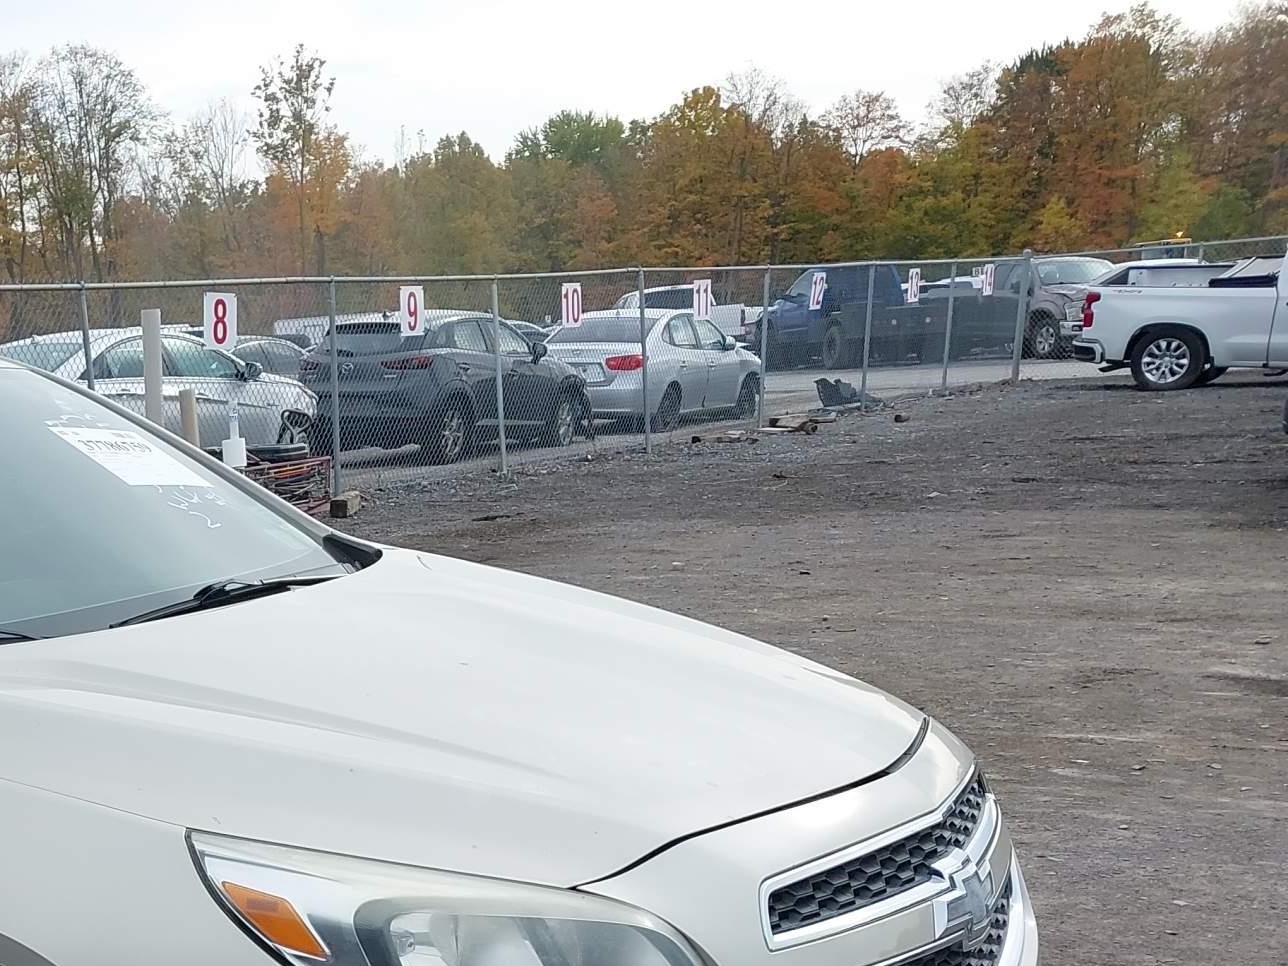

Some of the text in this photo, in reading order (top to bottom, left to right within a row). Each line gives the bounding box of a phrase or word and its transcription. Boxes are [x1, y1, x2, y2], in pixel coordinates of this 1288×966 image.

[813, 276, 825, 306] 12
[910, 271, 920, 299] 13
[984, 266, 993, 294] 14
[407, 291, 418, 332] 9
[563, 287, 580, 324] 10
[695, 283, 709, 317] 11
[213, 298, 227, 345] 8
